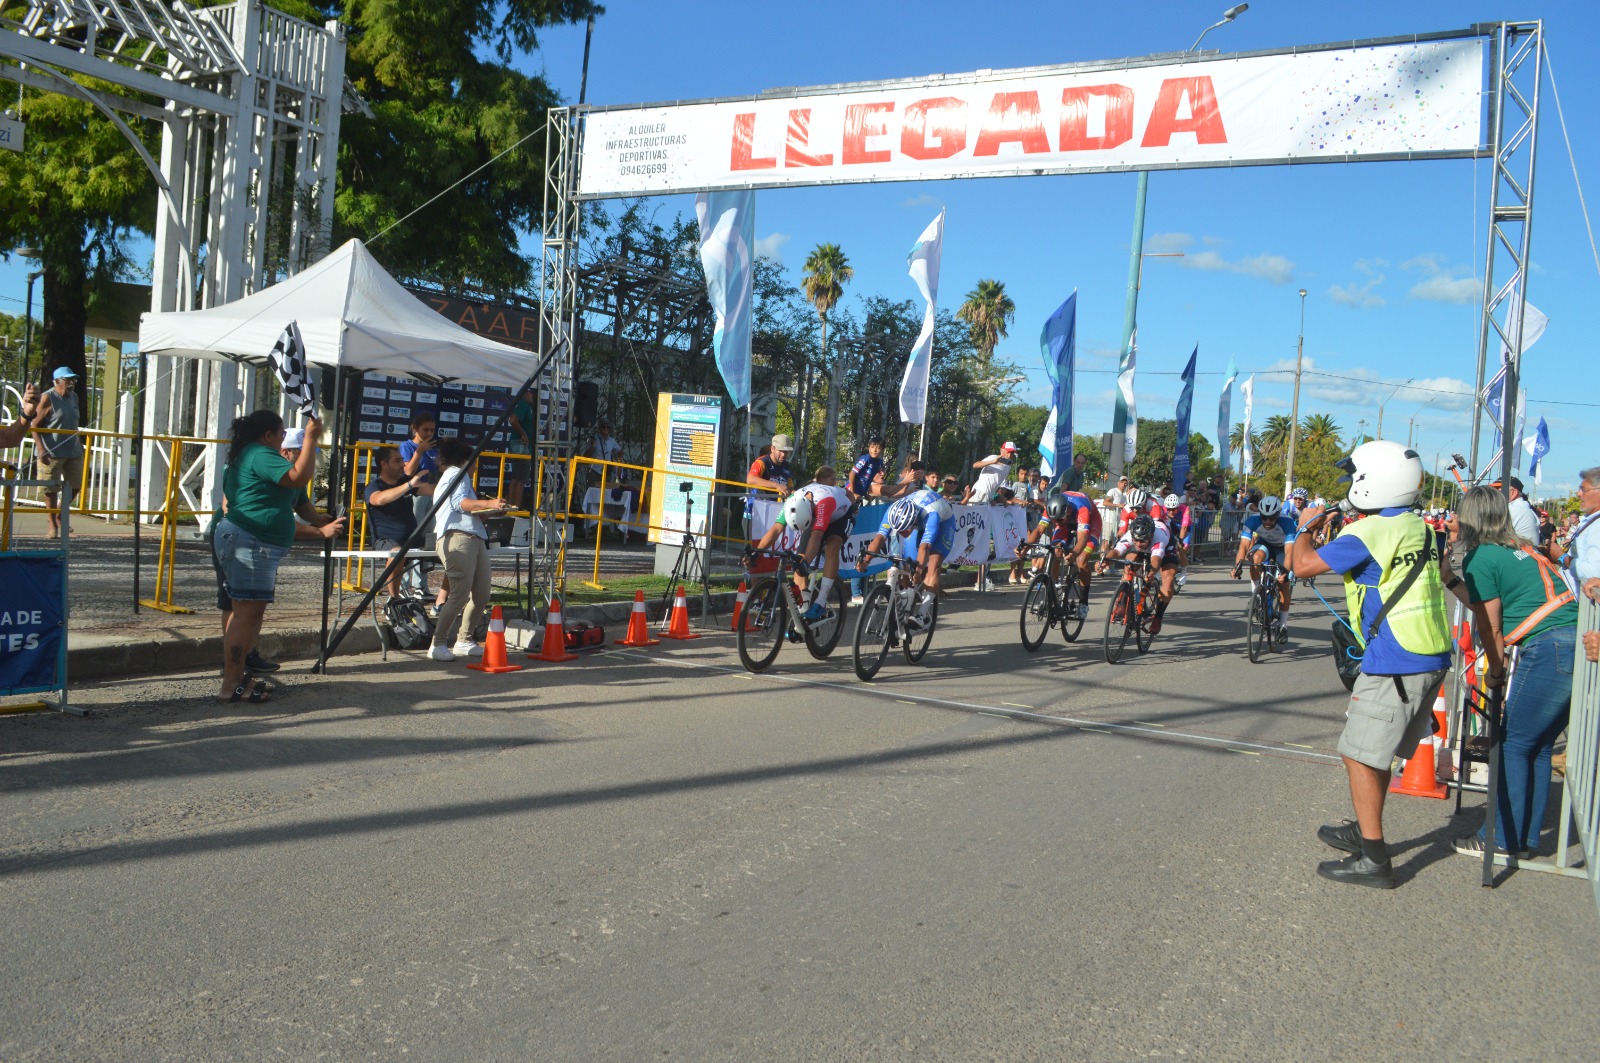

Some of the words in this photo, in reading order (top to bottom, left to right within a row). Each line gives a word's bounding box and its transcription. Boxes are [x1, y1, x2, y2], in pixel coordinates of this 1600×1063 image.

[628, 123, 666, 135] ALQUILER
[730, 75, 1228, 171] LLEGADA
[605, 134, 687, 150] INFRAESTRUCTURAS
[620, 163, 667, 176] 094626699
[1391, 548, 1438, 570] PRS
[17, 610, 42, 625] DE
